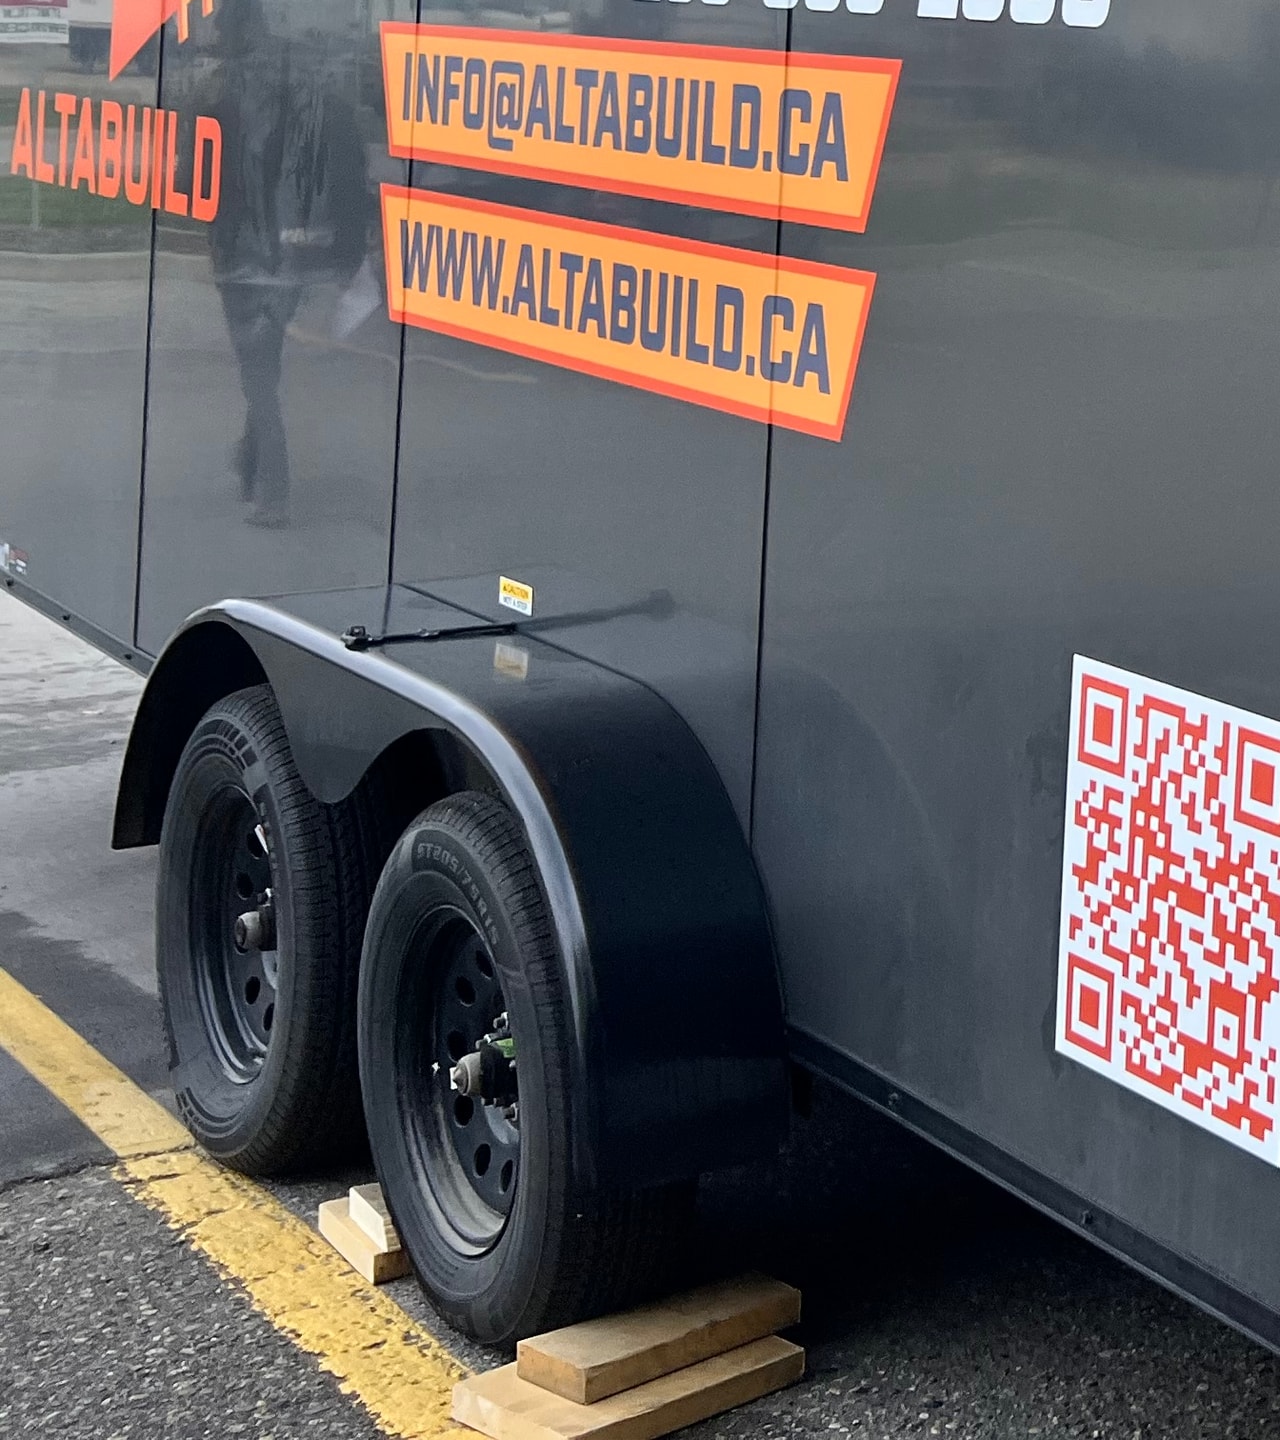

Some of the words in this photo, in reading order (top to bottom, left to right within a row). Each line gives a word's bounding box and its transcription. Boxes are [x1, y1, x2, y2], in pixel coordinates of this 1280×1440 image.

[10, 87, 223, 222] ALTABUILD
[402, 51, 849, 182] INFO@ALTABUILD.CA
[399, 219, 831, 395] WWW.ALTABUILD.CA
